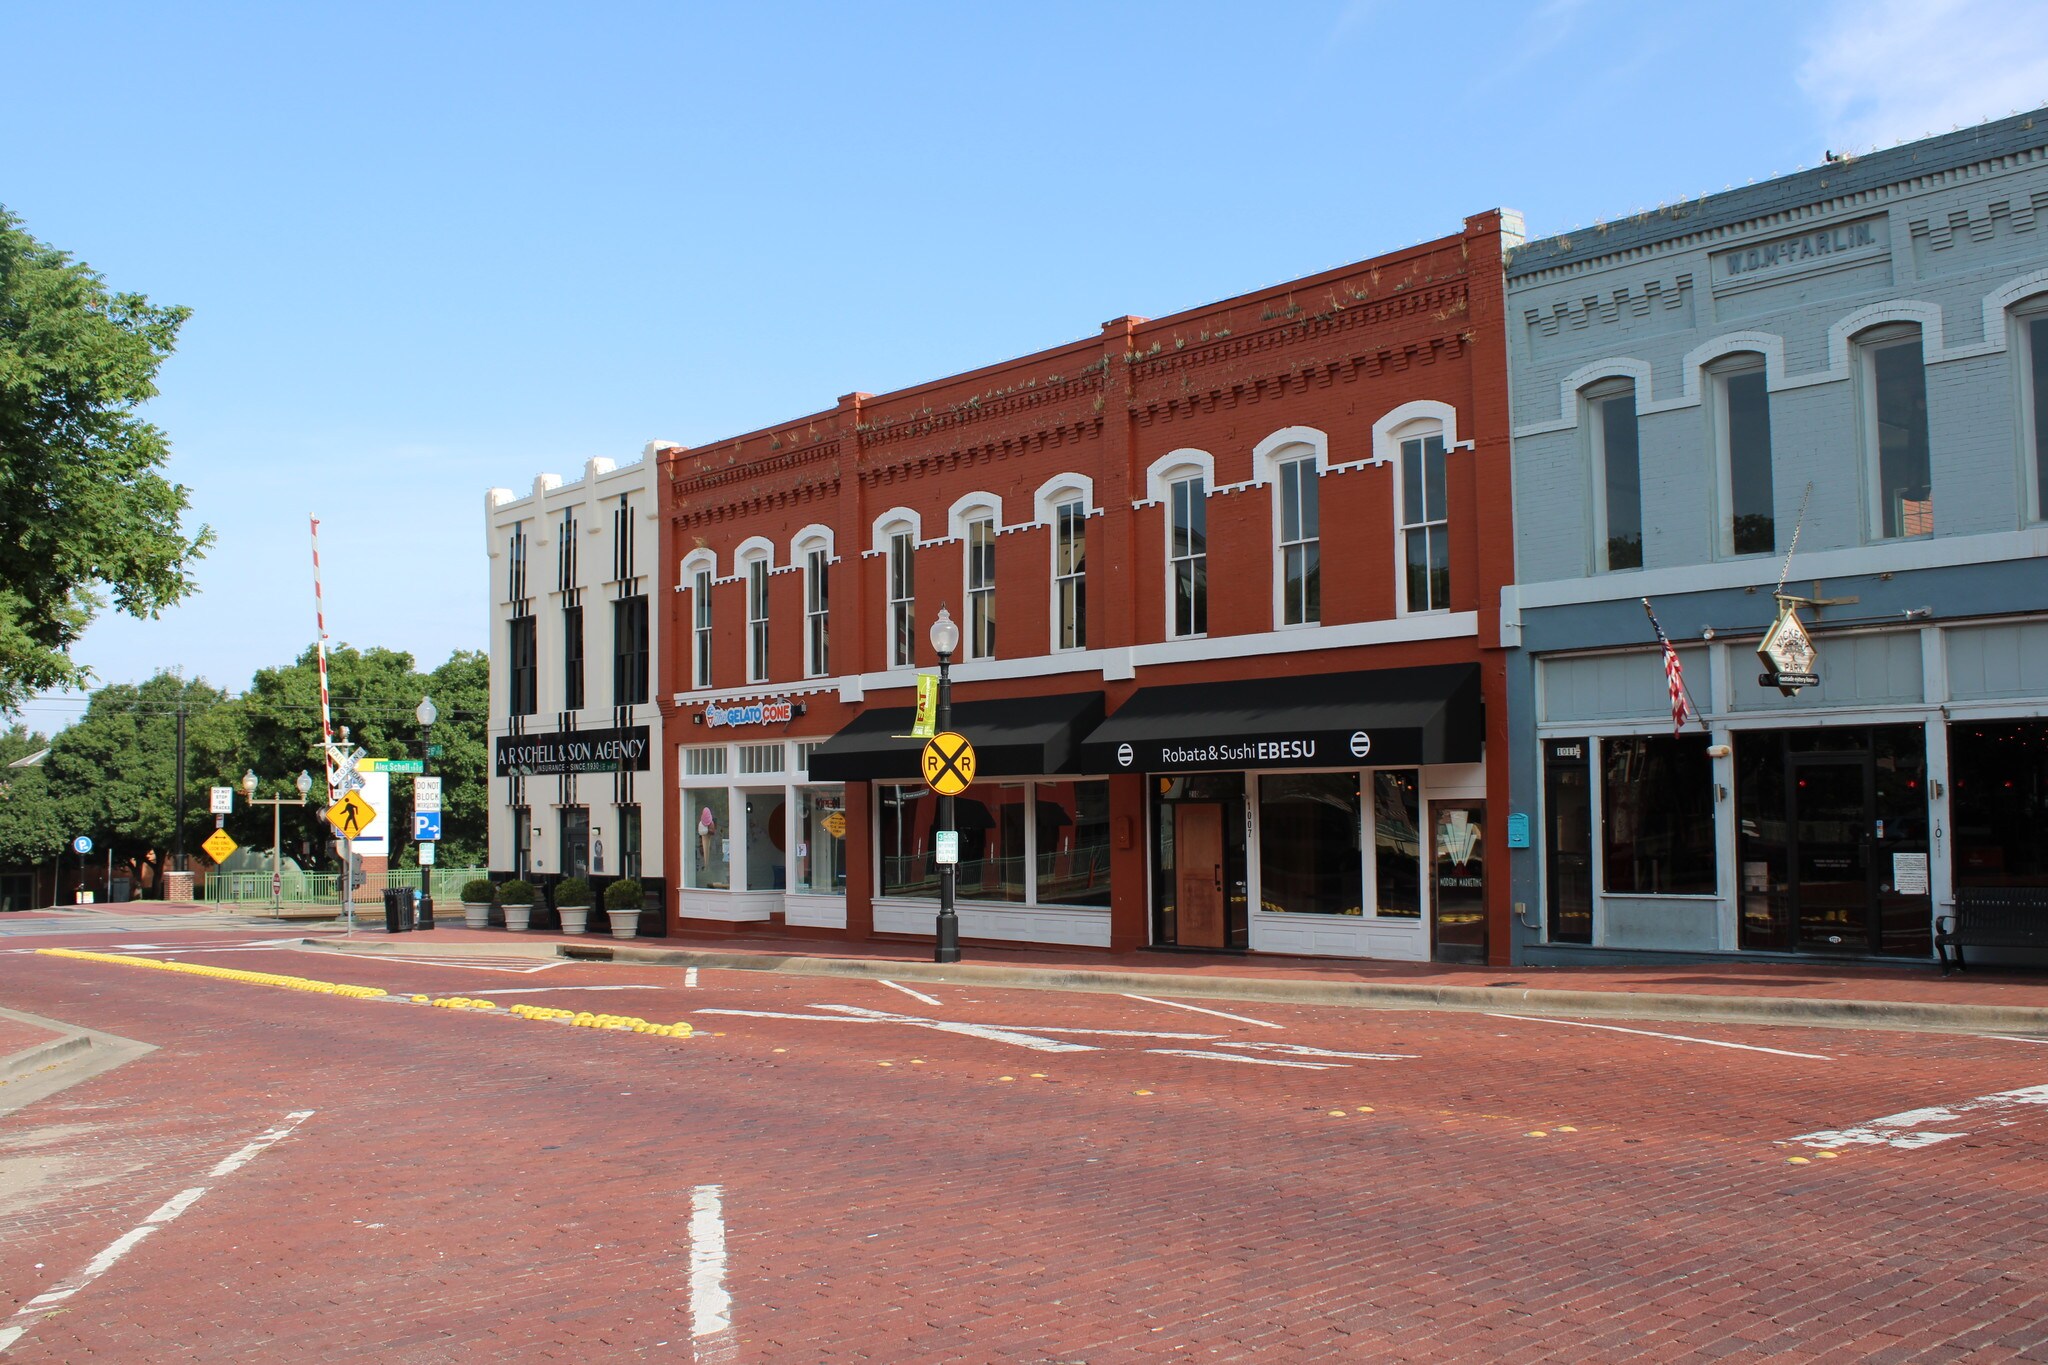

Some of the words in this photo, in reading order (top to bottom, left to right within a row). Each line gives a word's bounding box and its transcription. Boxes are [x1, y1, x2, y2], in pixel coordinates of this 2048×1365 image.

[1776, 629, 1809, 648] VICKERY
[1784, 662, 1803, 672] PARK
[727, 706, 762, 724] GELATO
[763, 705, 790, 723] CONE
[917, 693, 927, 722] EAT
[330, 749, 344, 766] RAIL
[497, 748, 507, 765] A
[508, 747, 516, 765] R
[517, 744, 557, 764] SCHELL
[558, 744, 567, 762] &
[567, 742, 591, 761] SON
[594, 738, 646, 760] AGENCY
[1257, 740, 1315, 760] EBESU
[332, 750, 363, 783] CROSSING
[375, 763, 388, 771] Alex
[389, 763, 410, 771] Schell
[570, 762, 586, 771] SINCE
[928, 756, 938, 771] R
[961, 757, 971, 771] R
[417, 782, 426, 790] DO
[427, 782, 439, 790] NOT
[417, 793, 439, 801] BLOCK
[416, 816, 429, 835] P
[1440, 877, 1457, 887] MODERN
[1459, 877, 1482, 888] MARKETING
